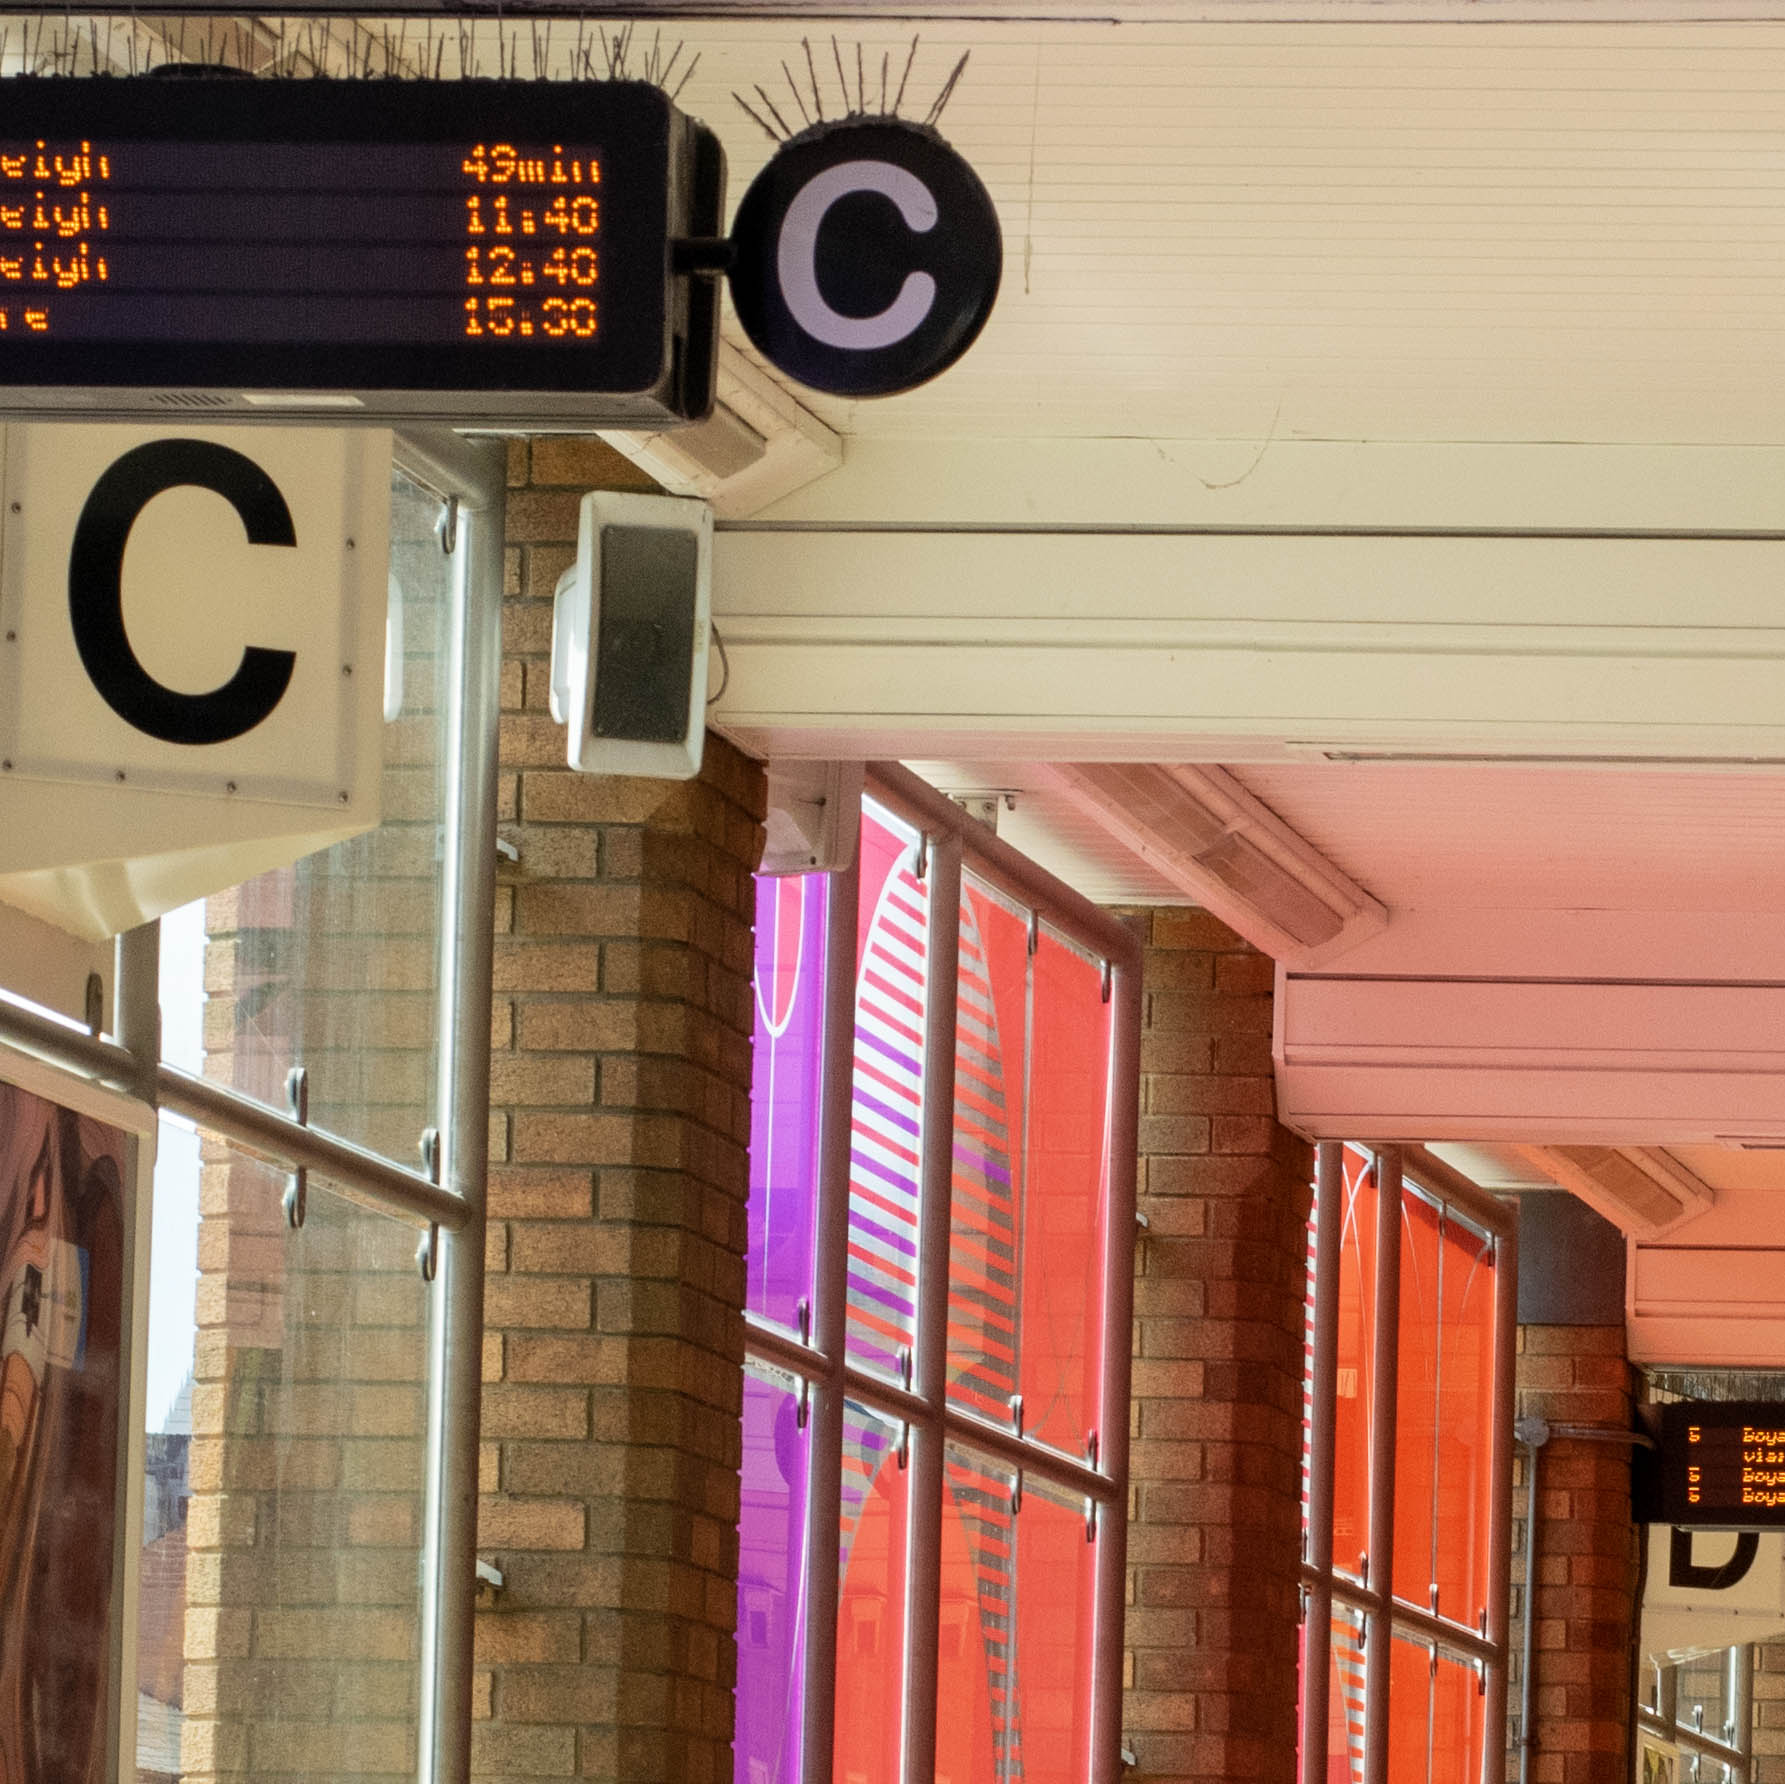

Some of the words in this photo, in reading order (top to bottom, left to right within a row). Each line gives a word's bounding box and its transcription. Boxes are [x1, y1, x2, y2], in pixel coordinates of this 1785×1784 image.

[462, 144, 600, 183] 49min
[467, 196, 598, 234] 11:40
[466, 246, 598, 285] 12:40
[778, 160, 938, 350] C
[465, 297, 597, 336] 15:30
[69, 439, 296, 745] C
[1744, 1449, 1785, 1463] via:
